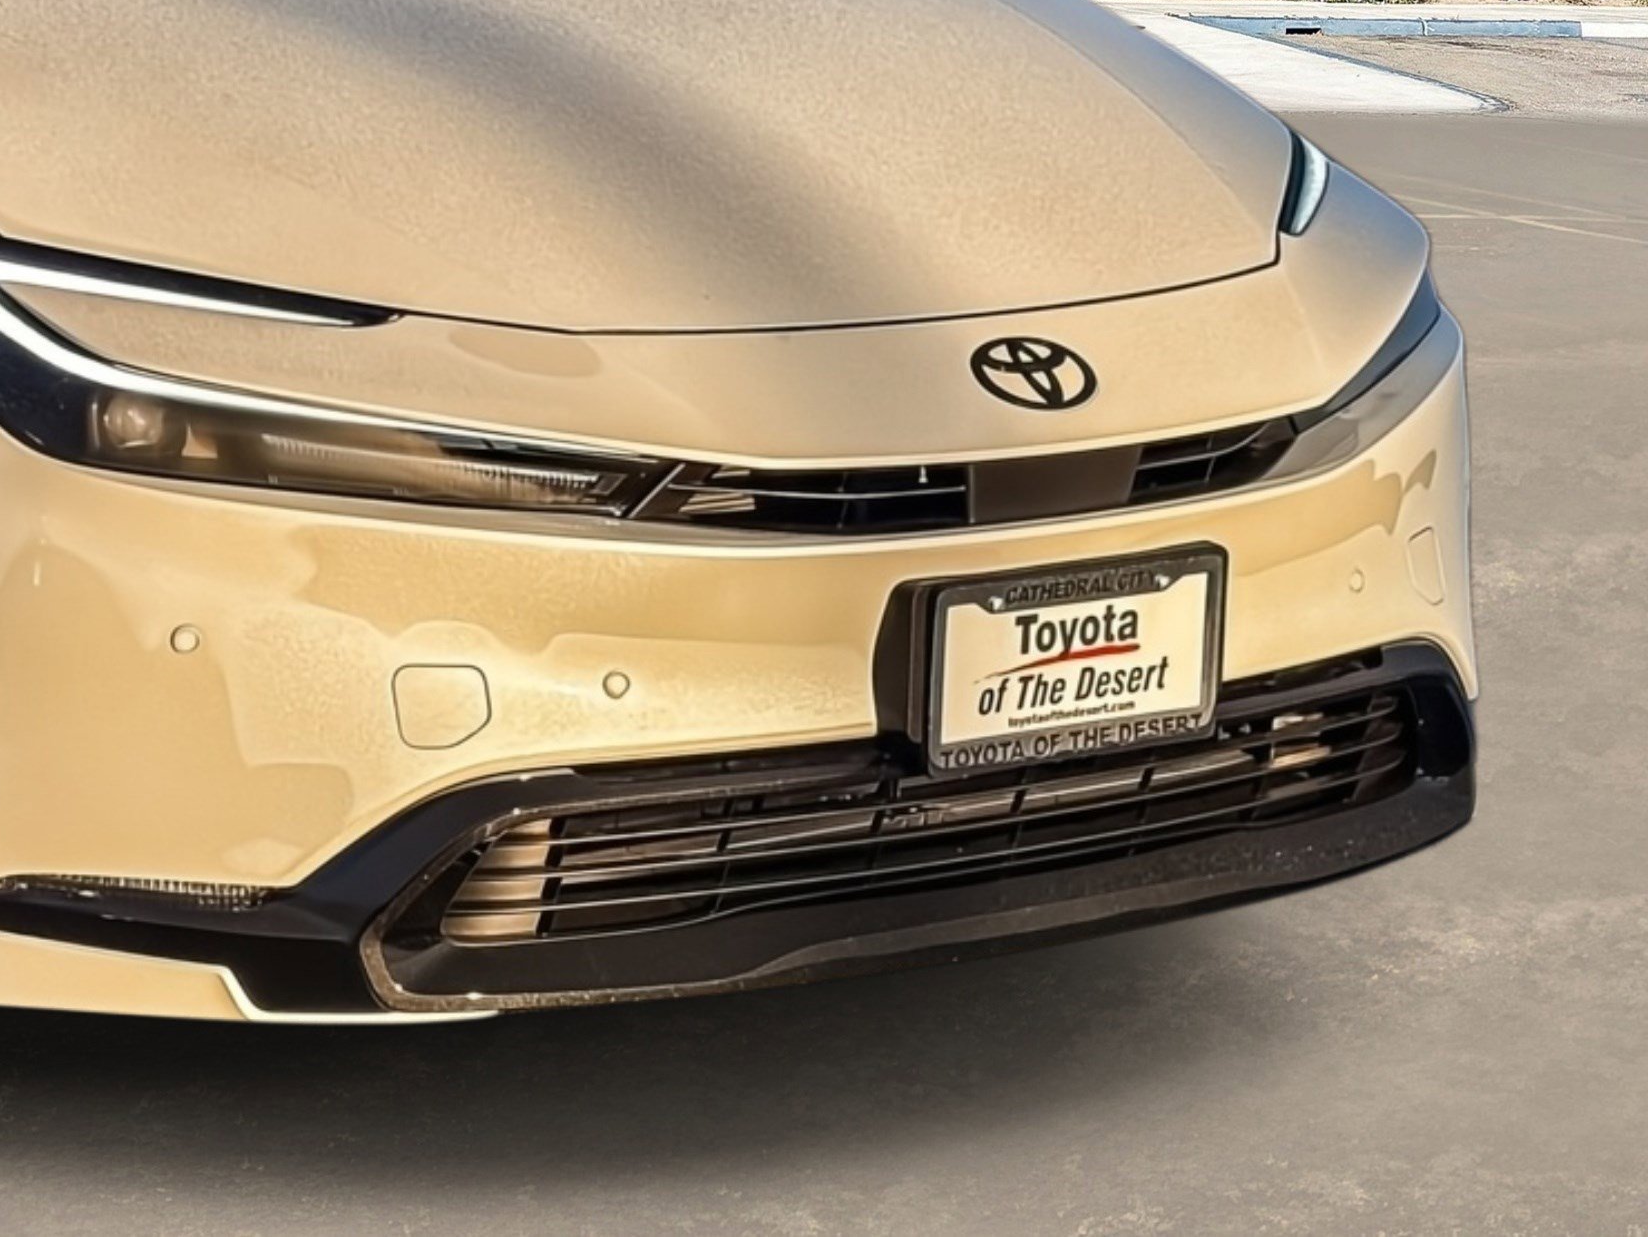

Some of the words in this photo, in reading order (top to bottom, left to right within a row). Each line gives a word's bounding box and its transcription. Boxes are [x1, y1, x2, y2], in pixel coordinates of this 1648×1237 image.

[1006, 577, 1111, 604] CATHEDRAL
[1015, 604, 1139, 656] Toyota
[978, 677, 1009, 716] of
[1017, 672, 1066, 710] The
[1074, 655, 1168, 701] Desert
[941, 740, 1024, 768] TOYOTA
[1033, 734, 1061, 756] OF
[1069, 726, 1111, 750] THE
[1118, 713, 1202, 742] DESERT
